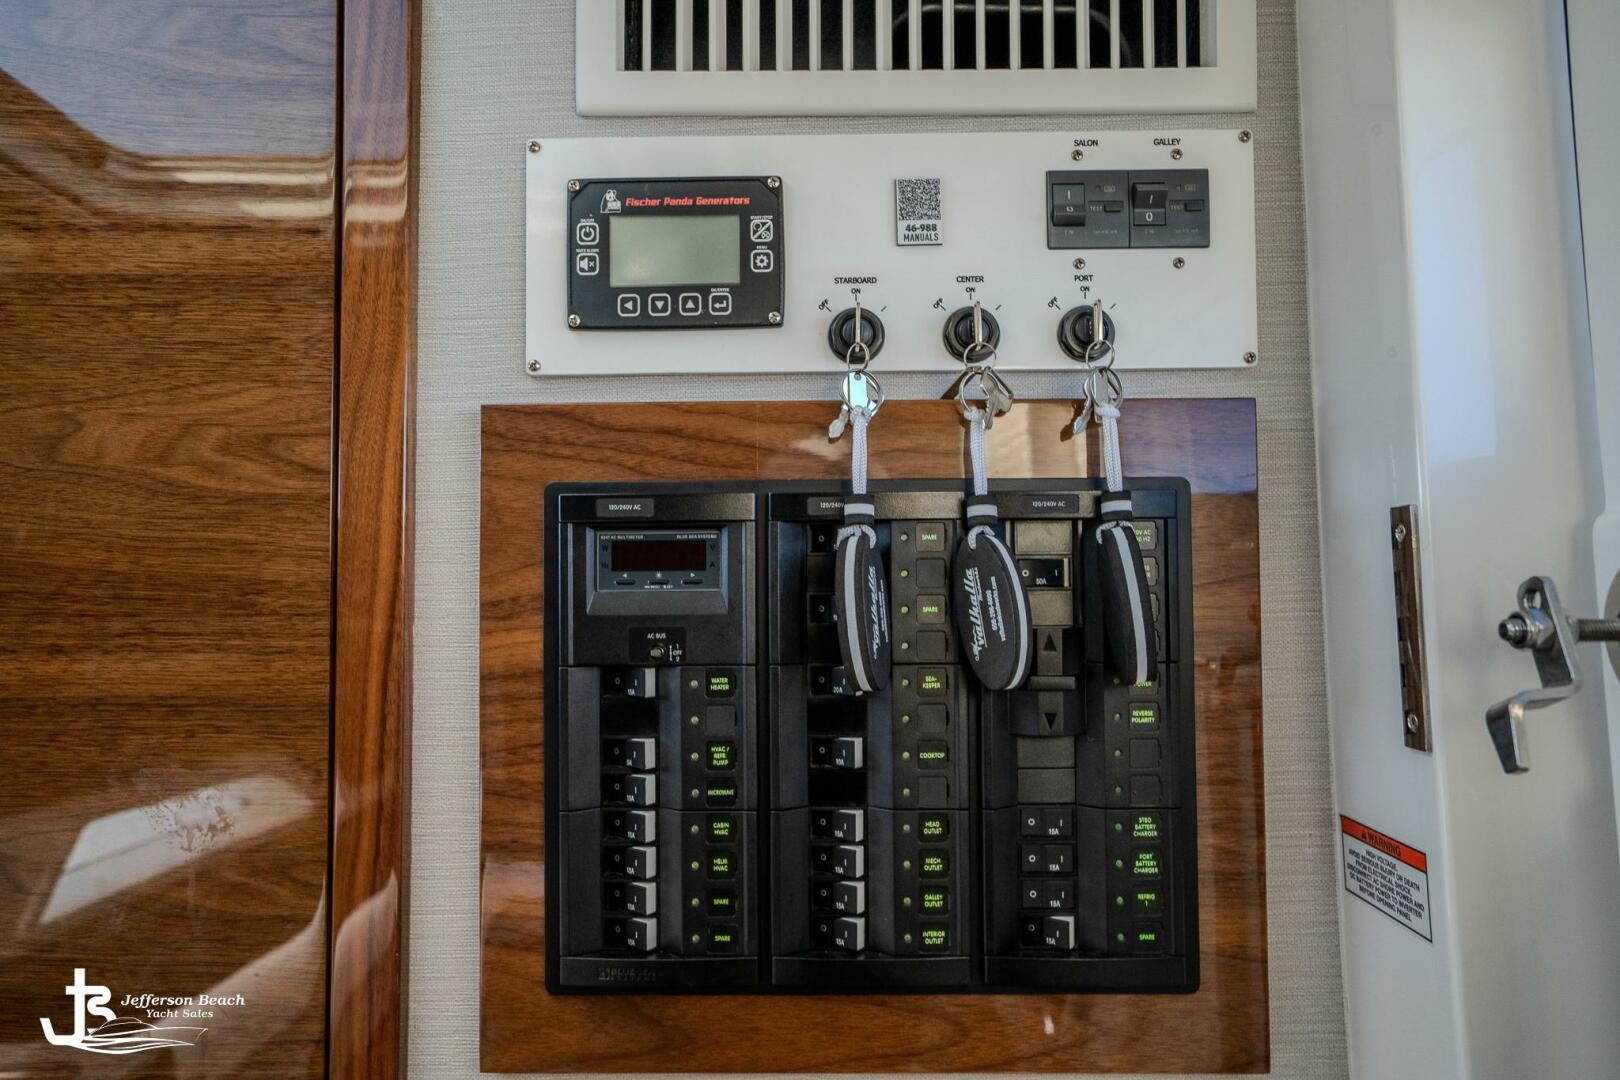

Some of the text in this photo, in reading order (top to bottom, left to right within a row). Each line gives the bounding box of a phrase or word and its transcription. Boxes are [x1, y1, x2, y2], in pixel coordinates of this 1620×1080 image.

[626, 197, 661, 207] Fischer
[664, 196, 693, 206] Panda
[696, 196, 750, 206] Generators
[905, 223, 938, 232] 46-988
[903, 233, 939, 242] MANUALS
[834, 276, 877, 284] STARBOARD
[818, 298, 829, 310] OFF
[932, 297, 944, 309] OFF
[1047, 296, 1058, 308] OFF
[1368, 832, 1401, 856] WARNING
